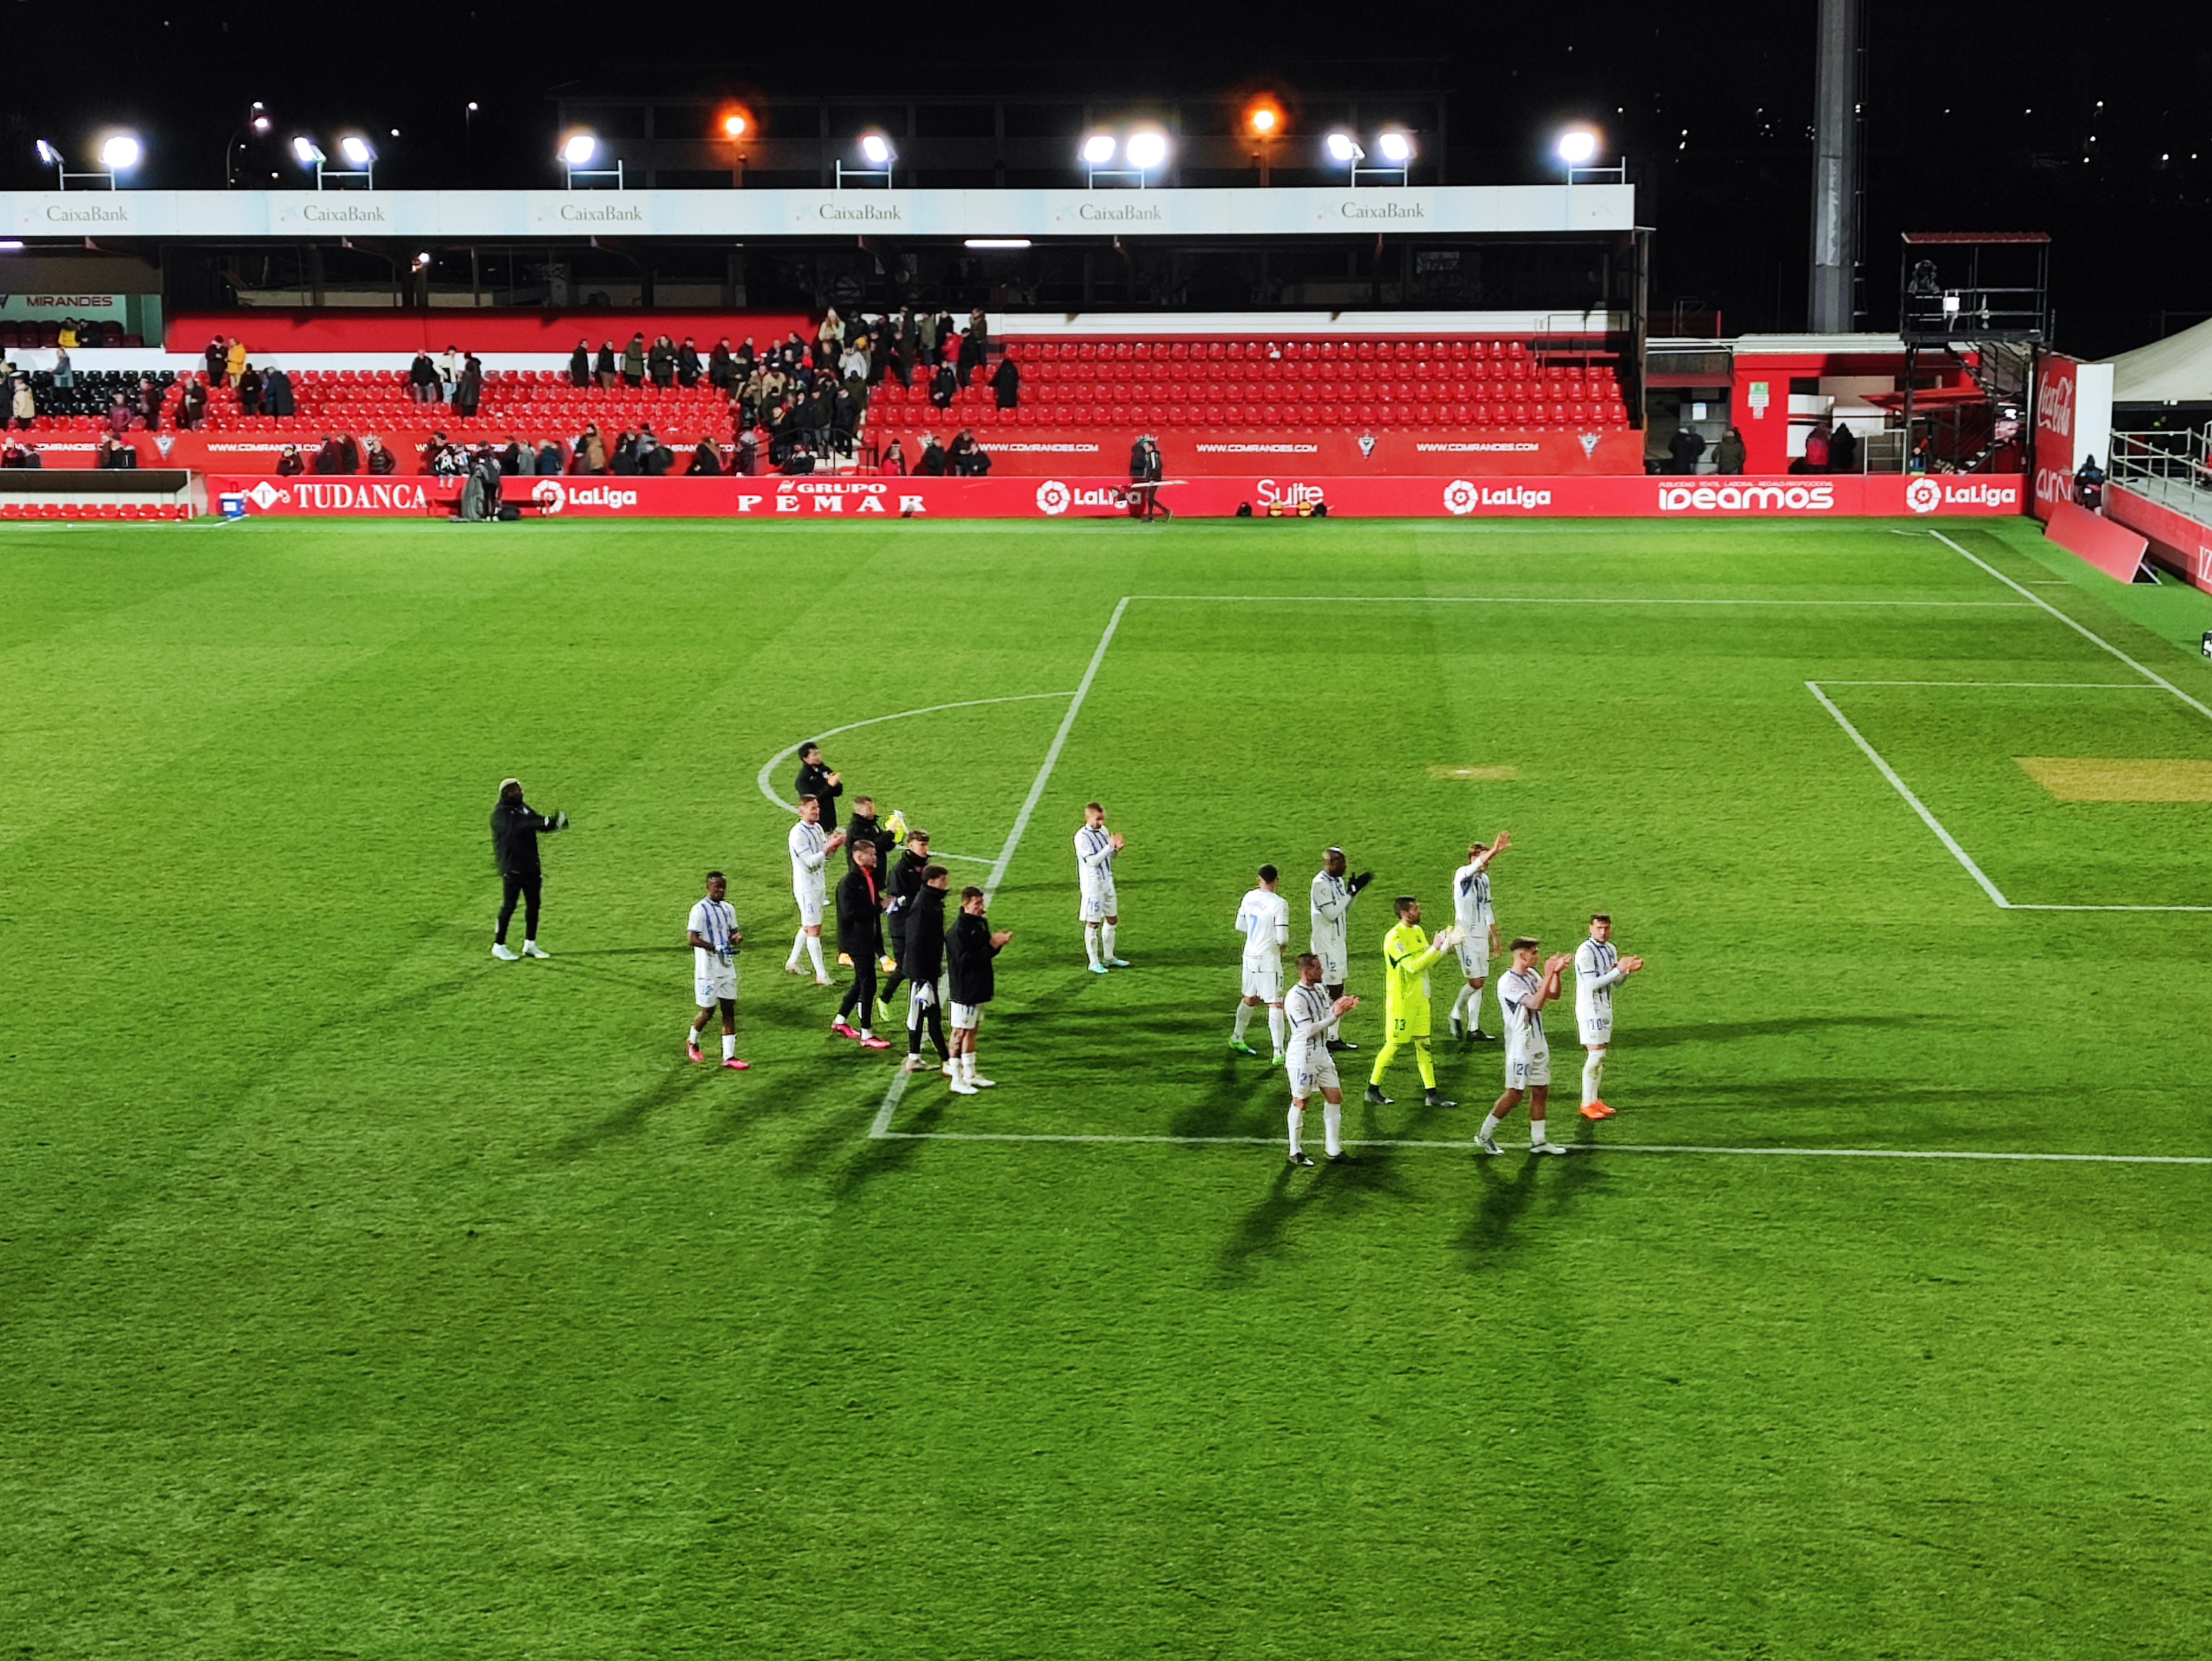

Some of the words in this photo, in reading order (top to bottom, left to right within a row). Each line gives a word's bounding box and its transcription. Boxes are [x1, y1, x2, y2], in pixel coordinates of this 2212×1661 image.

[47, 206, 128, 221] CaixaBank
[304, 205, 385, 221] CaixaBank
[561, 205, 642, 221] CaixaBank
[819, 204, 902, 220] CaixaBank
[1080, 204, 1161, 220] CaixaBank
[1341, 202, 1425, 218] CaixaBank
[27, 296, 113, 307] MIRANDES
[294, 484, 428, 509] TUDANCA
[796, 483, 887, 494] GRUPO
[1257, 479, 1324, 506] Suite
[1945, 484, 2016, 507] LaLiga
[569, 486, 637, 509] LaLiga
[737, 495, 926, 512] PEMAR
[1482, 486, 1551, 509] LaLiga
[1249, 914, 1258, 942] 7
[1394, 1019, 1406, 1030] 13
[1590, 1019, 1603, 1030] 10
